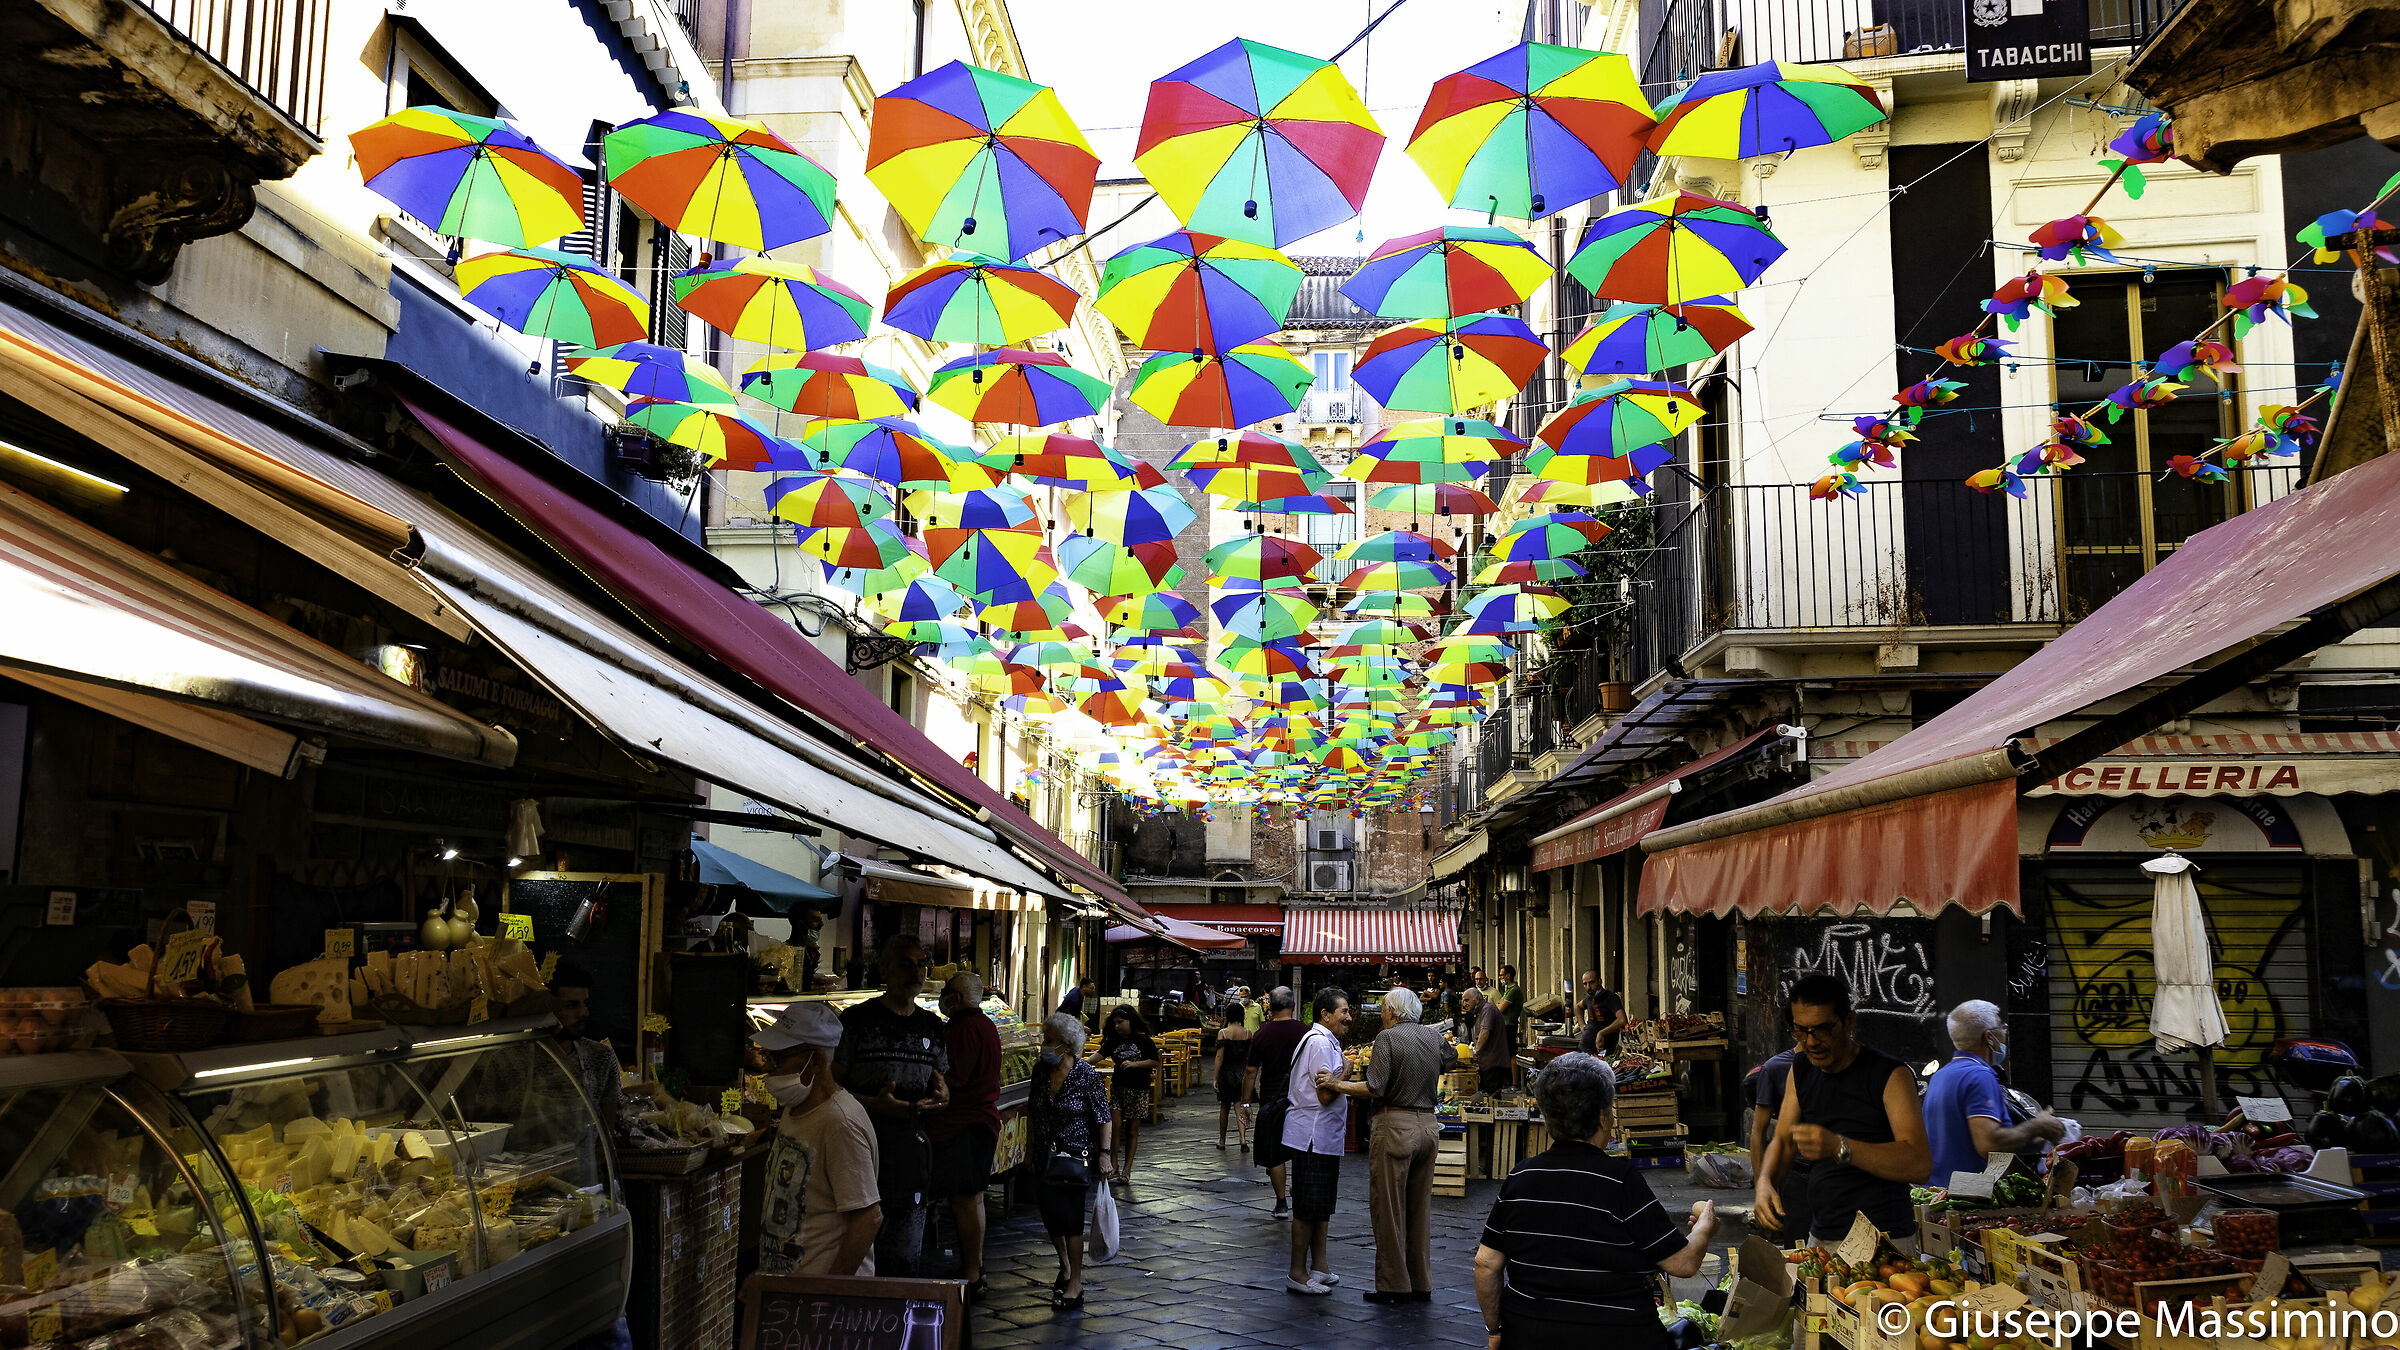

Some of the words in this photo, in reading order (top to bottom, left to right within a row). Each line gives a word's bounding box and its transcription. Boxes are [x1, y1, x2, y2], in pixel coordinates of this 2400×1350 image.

[1977, 42, 2083, 67] TABACCHI
[437, 665, 489, 700] SALUMI
[491, 679, 501, 703] E
[501, 684, 561, 720] FORMAGGI
[1217, 925, 1276, 933] Bonaccorso
[1320, 955, 1370, 963] Antica
[1384, 955, 1462, 963] Salumeria
